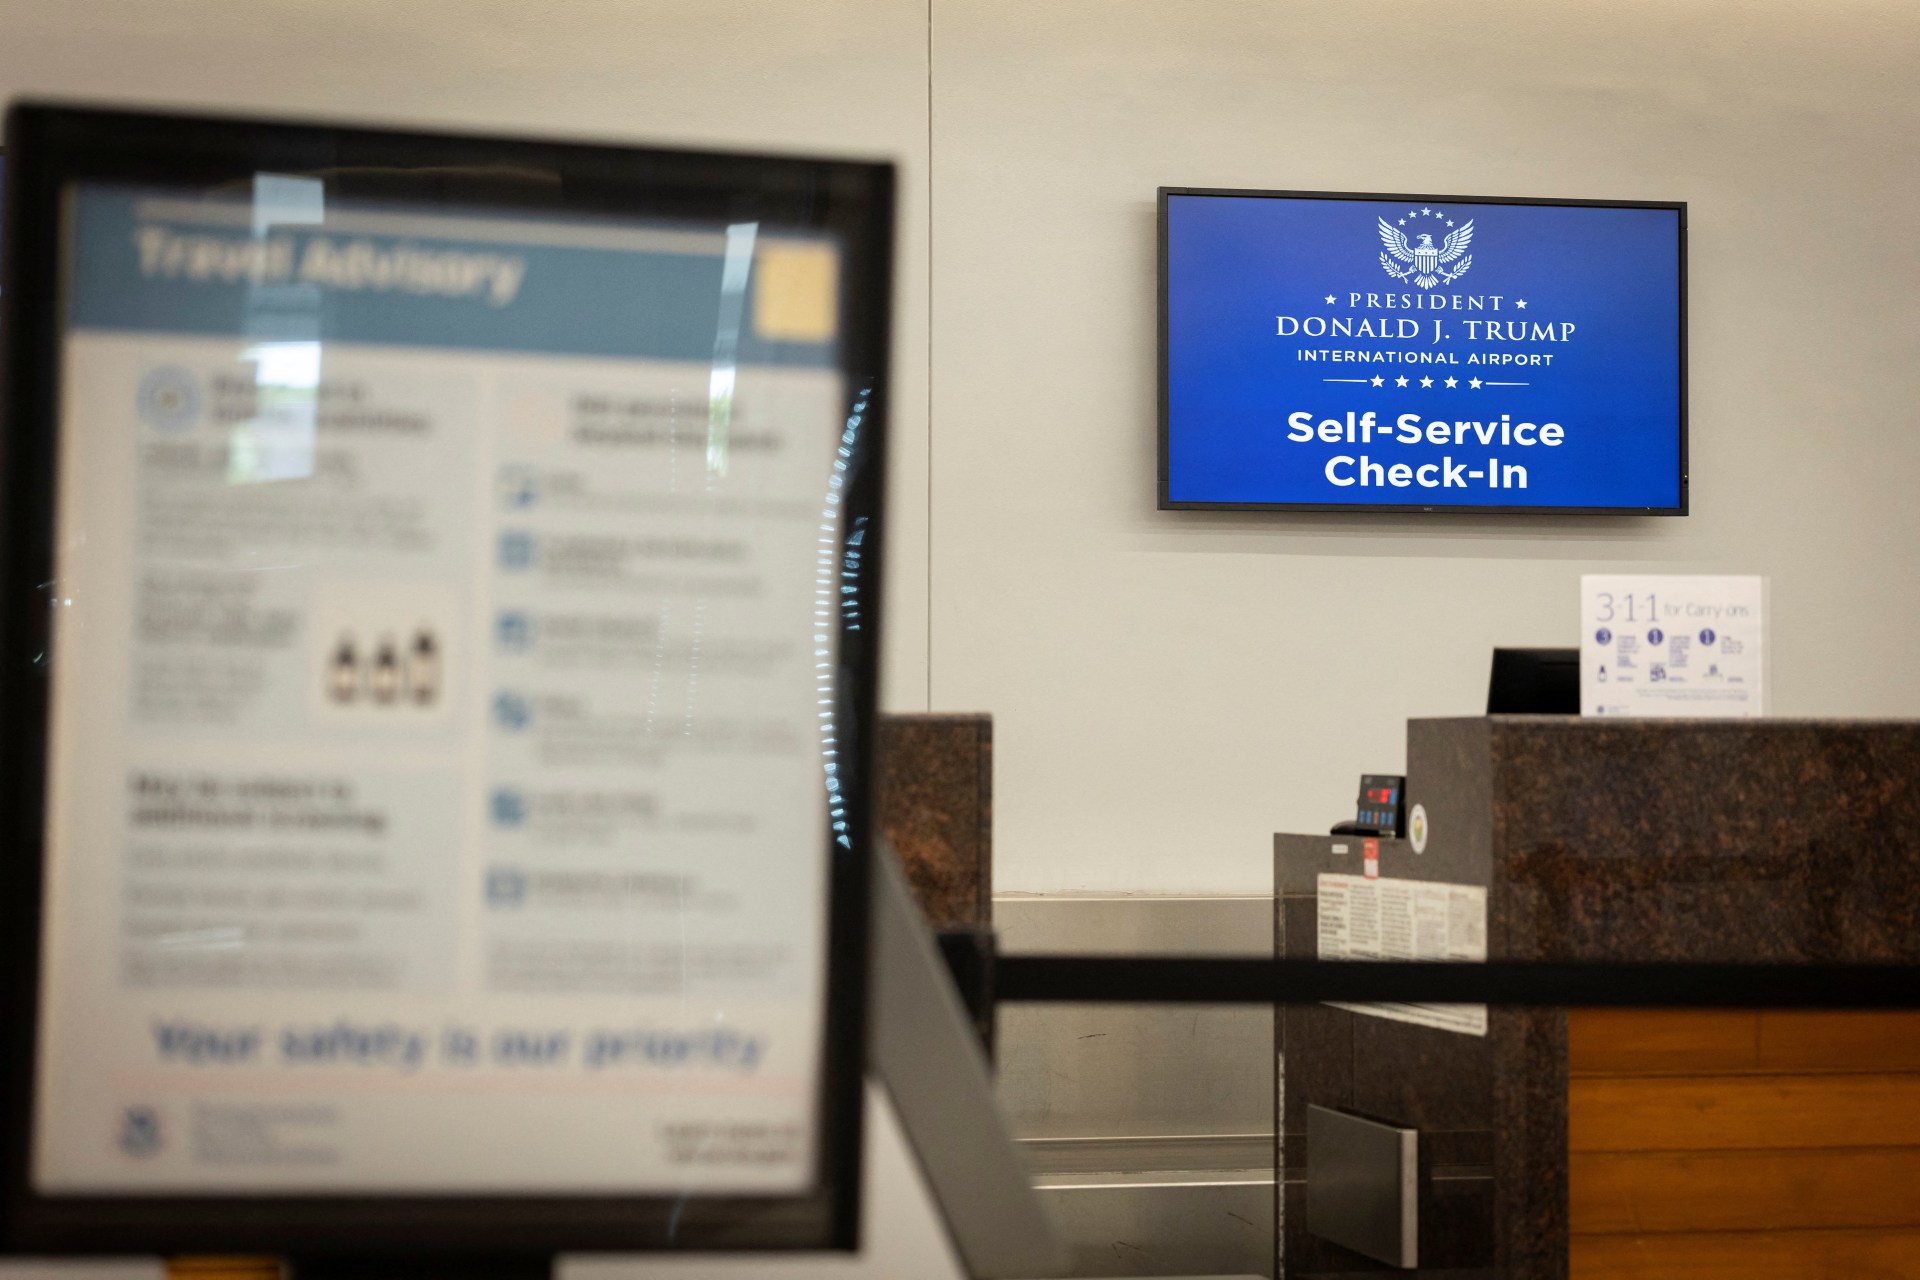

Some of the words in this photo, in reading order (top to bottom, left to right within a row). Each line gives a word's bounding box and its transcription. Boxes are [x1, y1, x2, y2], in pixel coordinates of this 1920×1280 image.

[138, 226, 294, 282] Travel
[299, 238, 524, 307] Advisory
[1349, 292, 1504, 311] PRESIDENT
[1276, 315, 1420, 339] DONALD
[1432, 319, 1450, 345] J.
[1462, 320, 1576, 343] TRUMP
[1297, 349, 1459, 365] INTERNATIONAL
[1467, 353, 1554, 367] AIRPORT
[1287, 411, 1565, 447] Self-Service
[1324, 455, 1528, 489] Check-In
[1664, 602, 1682, 617] for
[154, 1022, 261, 1066] Your
[280, 1018, 424, 1076] safety
[440, 1023, 478, 1066] is
[492, 1026, 569, 1067] our
[584, 1023, 769, 1074] priority
